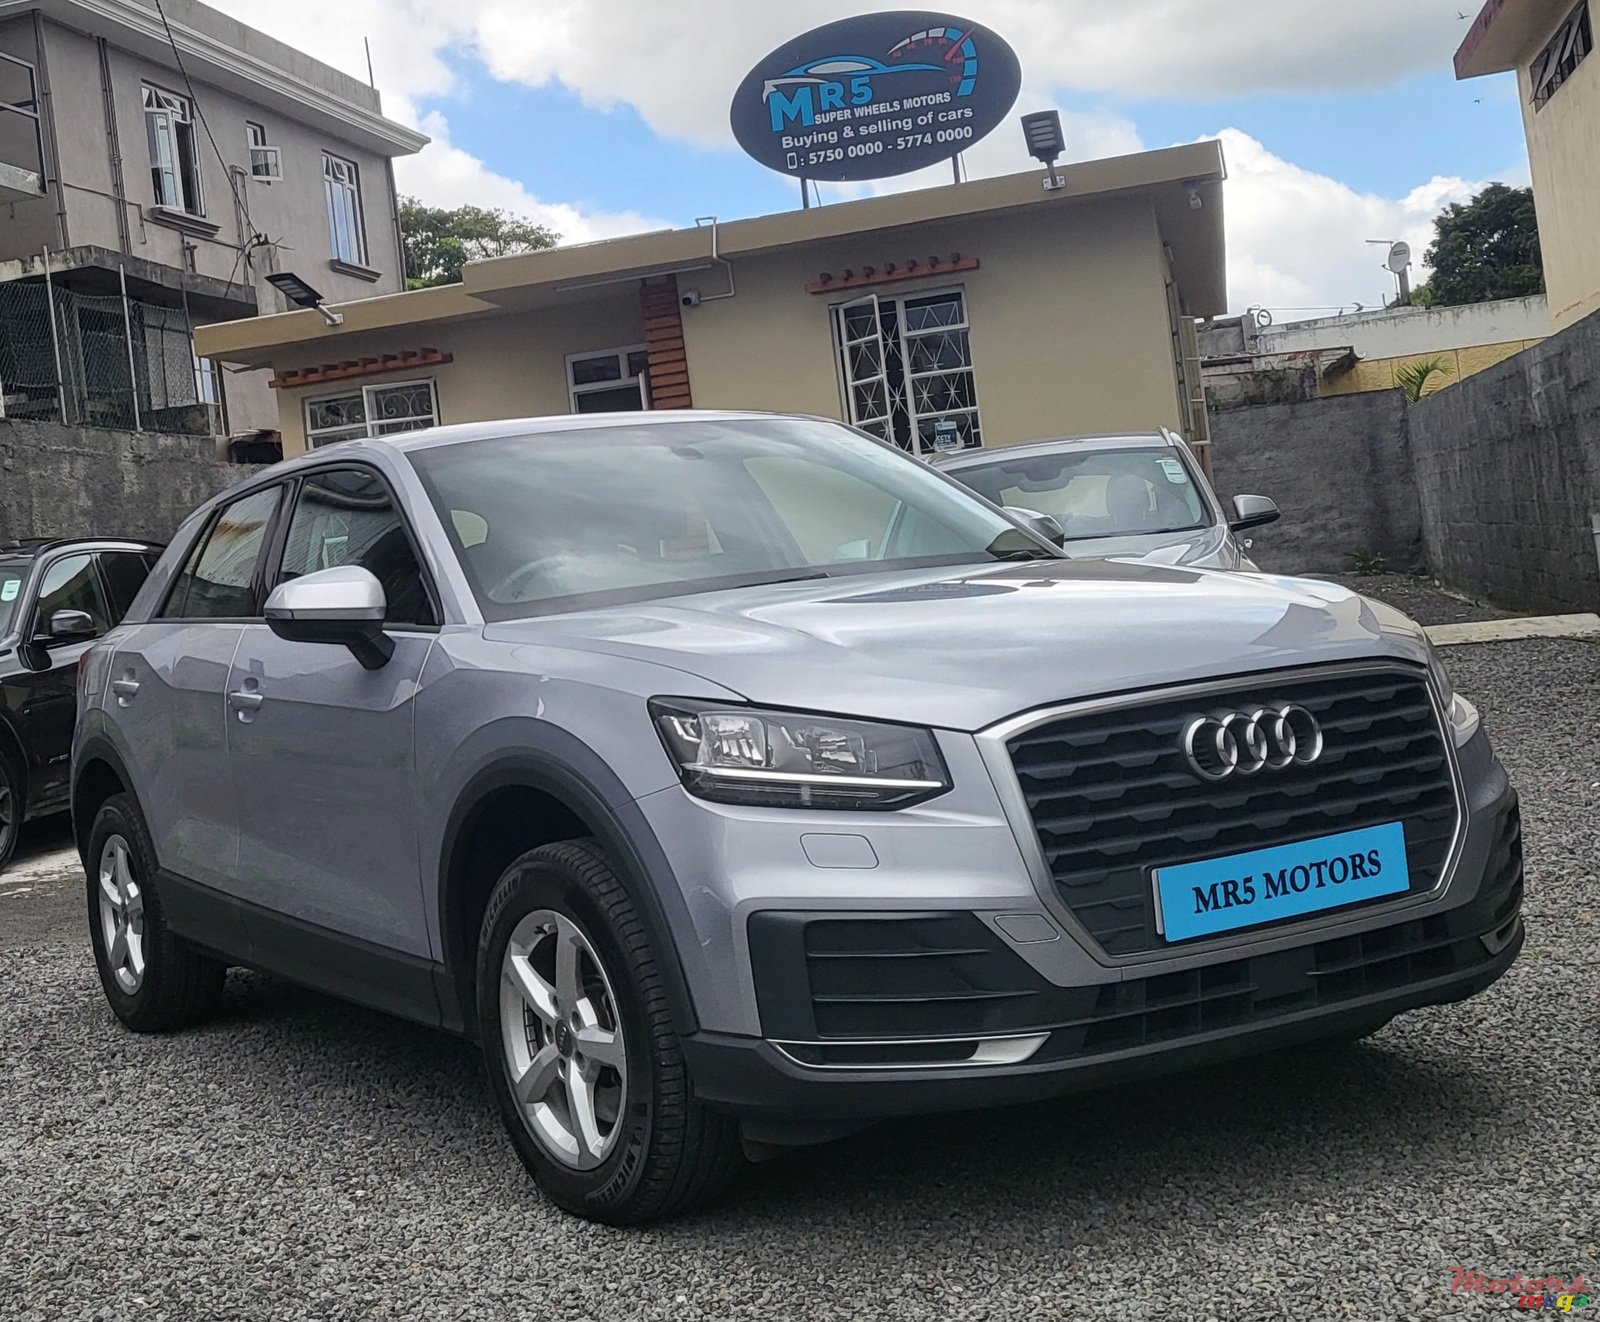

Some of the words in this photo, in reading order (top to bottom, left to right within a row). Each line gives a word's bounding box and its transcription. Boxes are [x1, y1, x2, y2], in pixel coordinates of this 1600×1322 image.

[769, 77, 873, 132] MR5
[814, 108, 852, 125] SUPER
[853, 101, 901, 119] WHEELS
[903, 91, 951, 110] MOTORS
[781, 130, 838, 149] Buying
[843, 125, 855, 139] &
[858, 118, 913, 136] selling
[917, 111, 934, 126] of
[938, 107, 973, 122] cars
[808, 147, 844, 165] 5750
[847, 140, 883, 158] 0000
[896, 132, 933, 150] 5774
[936, 126, 973, 143] 0000
[1191, 876, 1257, 914] MR5
[1262, 849, 1382, 900] MOTORS
